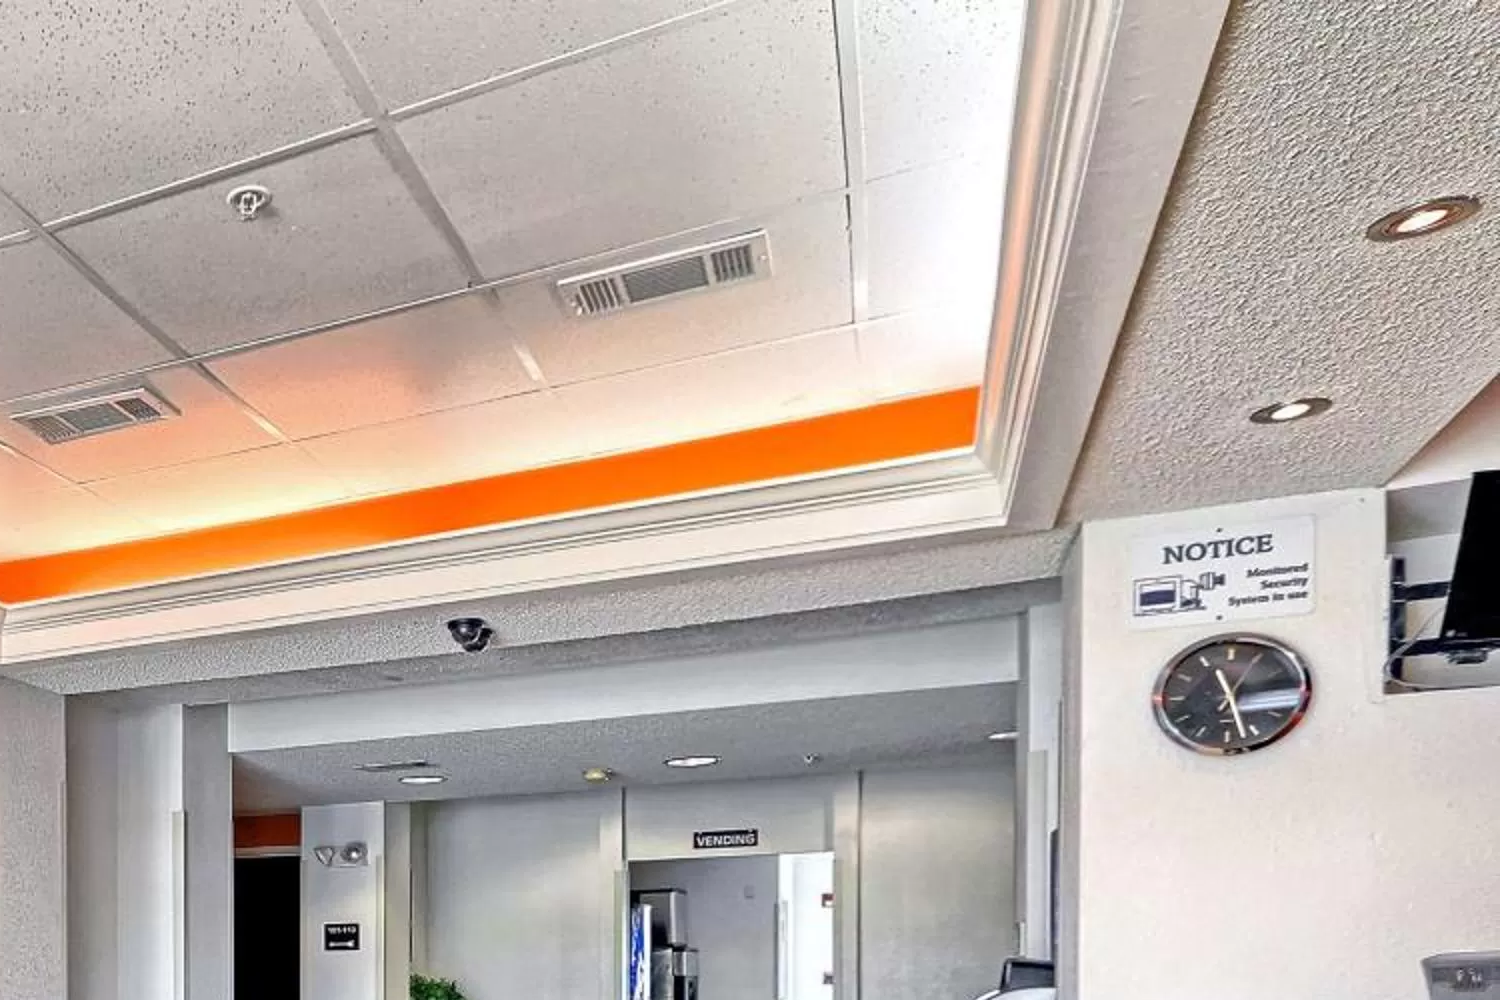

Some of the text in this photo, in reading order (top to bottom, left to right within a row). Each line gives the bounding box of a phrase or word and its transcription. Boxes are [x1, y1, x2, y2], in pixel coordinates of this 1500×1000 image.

[1163, 534, 1274, 564] NOTICE
[1260, 578, 1308, 590] Security
[1228, 591, 1308, 607] System in use
[696, 833, 755, 847] VENDING
